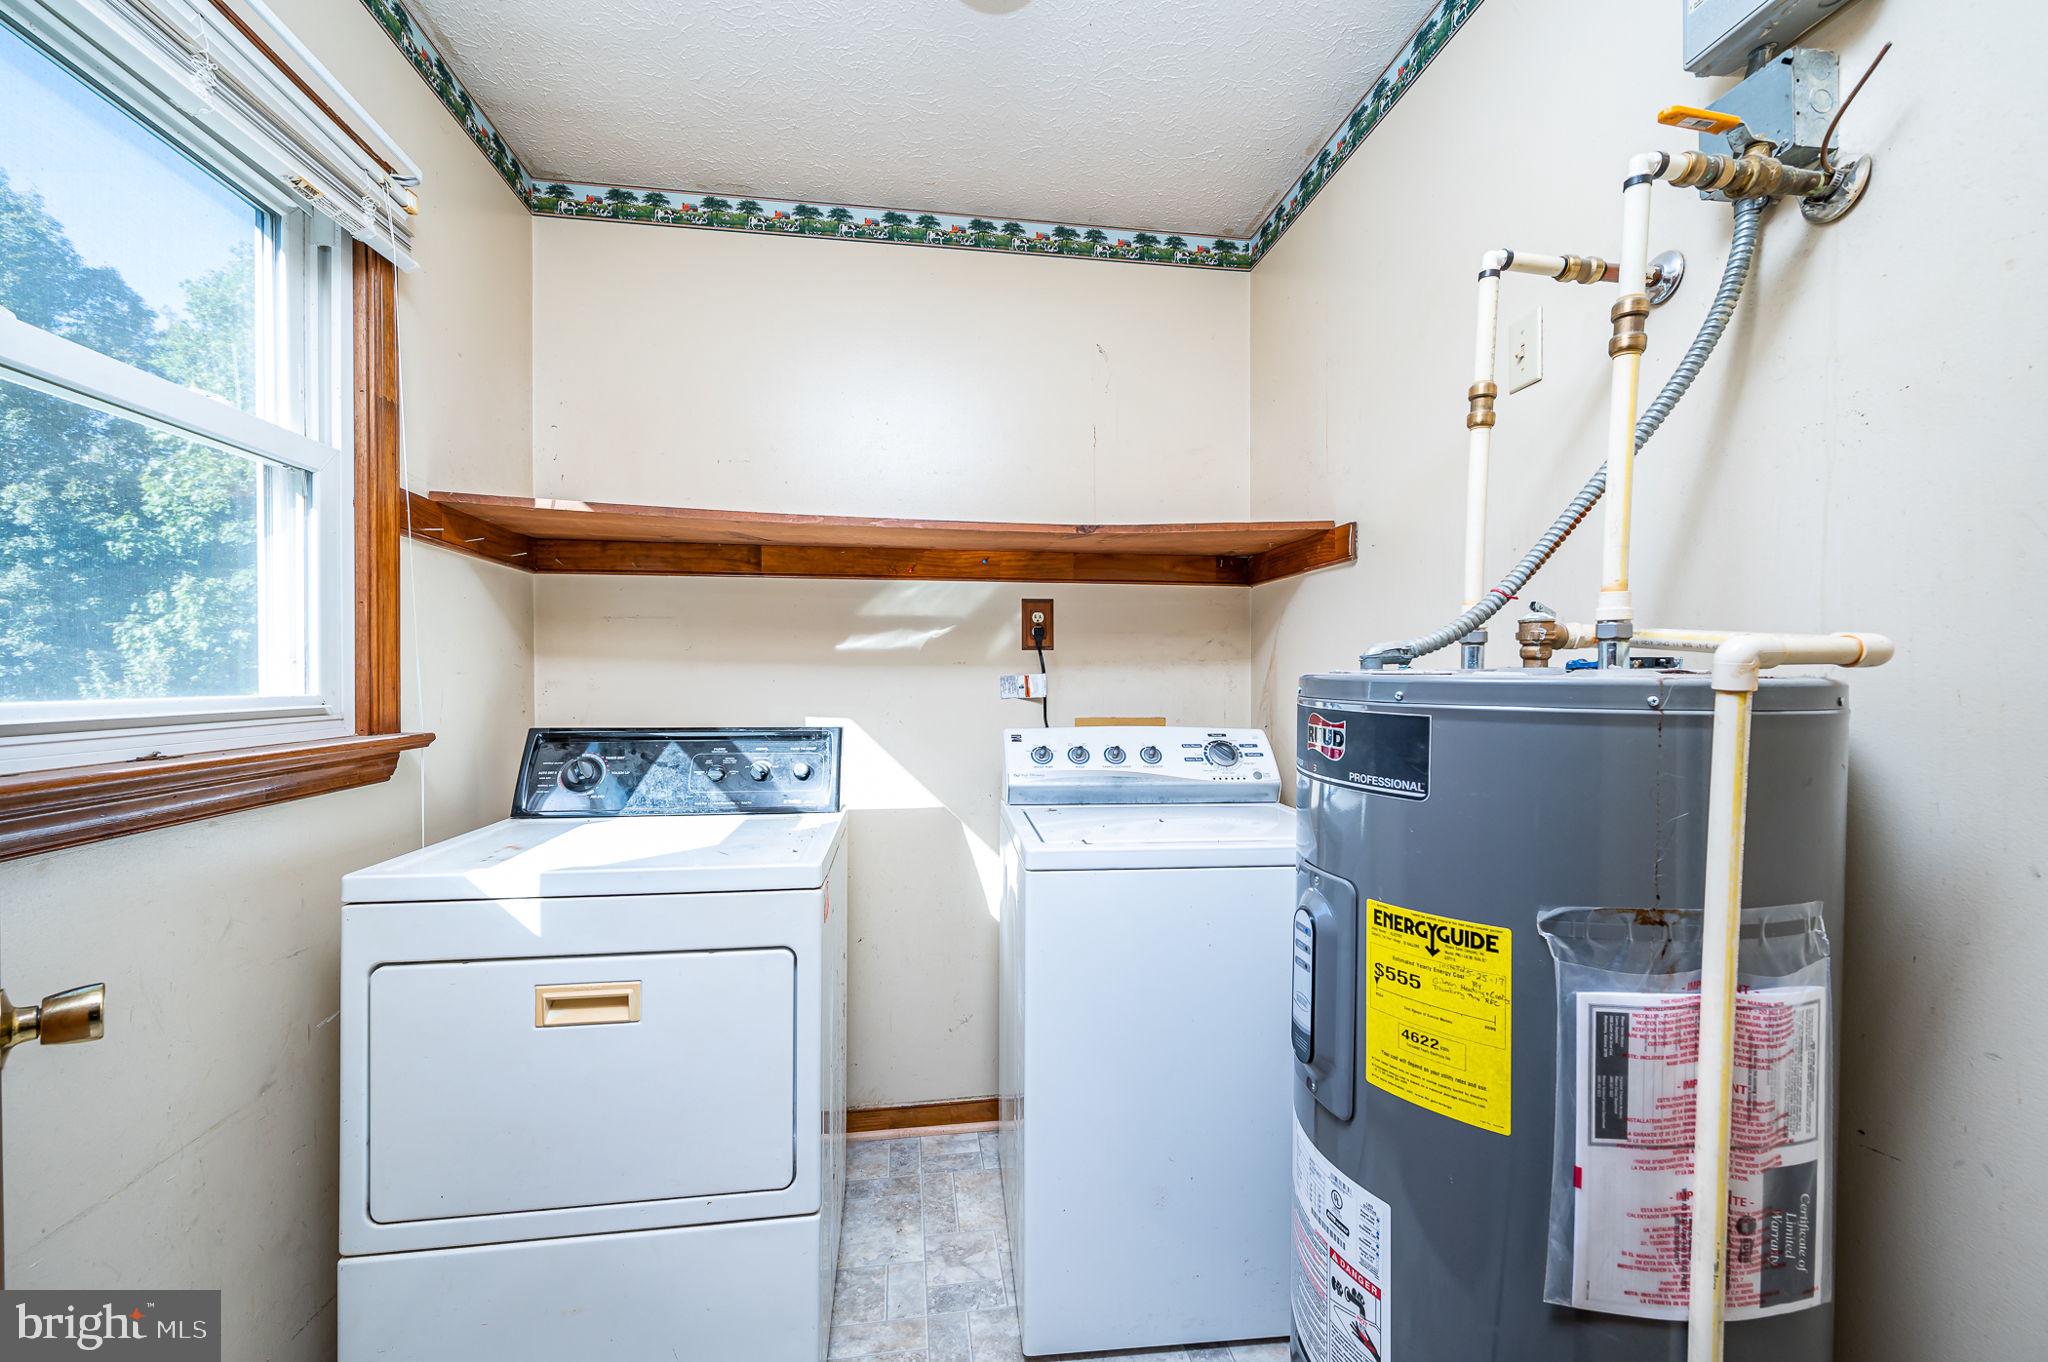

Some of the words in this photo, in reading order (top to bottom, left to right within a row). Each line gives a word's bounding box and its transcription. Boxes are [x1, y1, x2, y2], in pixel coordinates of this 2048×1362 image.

[1349, 772, 1425, 792] PROFESSIONAL
[1374, 908, 1499, 956] ENERGYGUIDE
[1374, 962, 1422, 990] $555
[1433, 967, 1452, 977] Energy
[1401, 1029, 1440, 1050] 4622
[1767, 1210, 1783, 1265] Warranty
[1784, 1212, 1797, 1259] Limited
[1798, 1193, 1811, 1258] Certificate
[1340, 1258, 1378, 1296] DANGER
[1796, 1258, 1808, 1274] of
